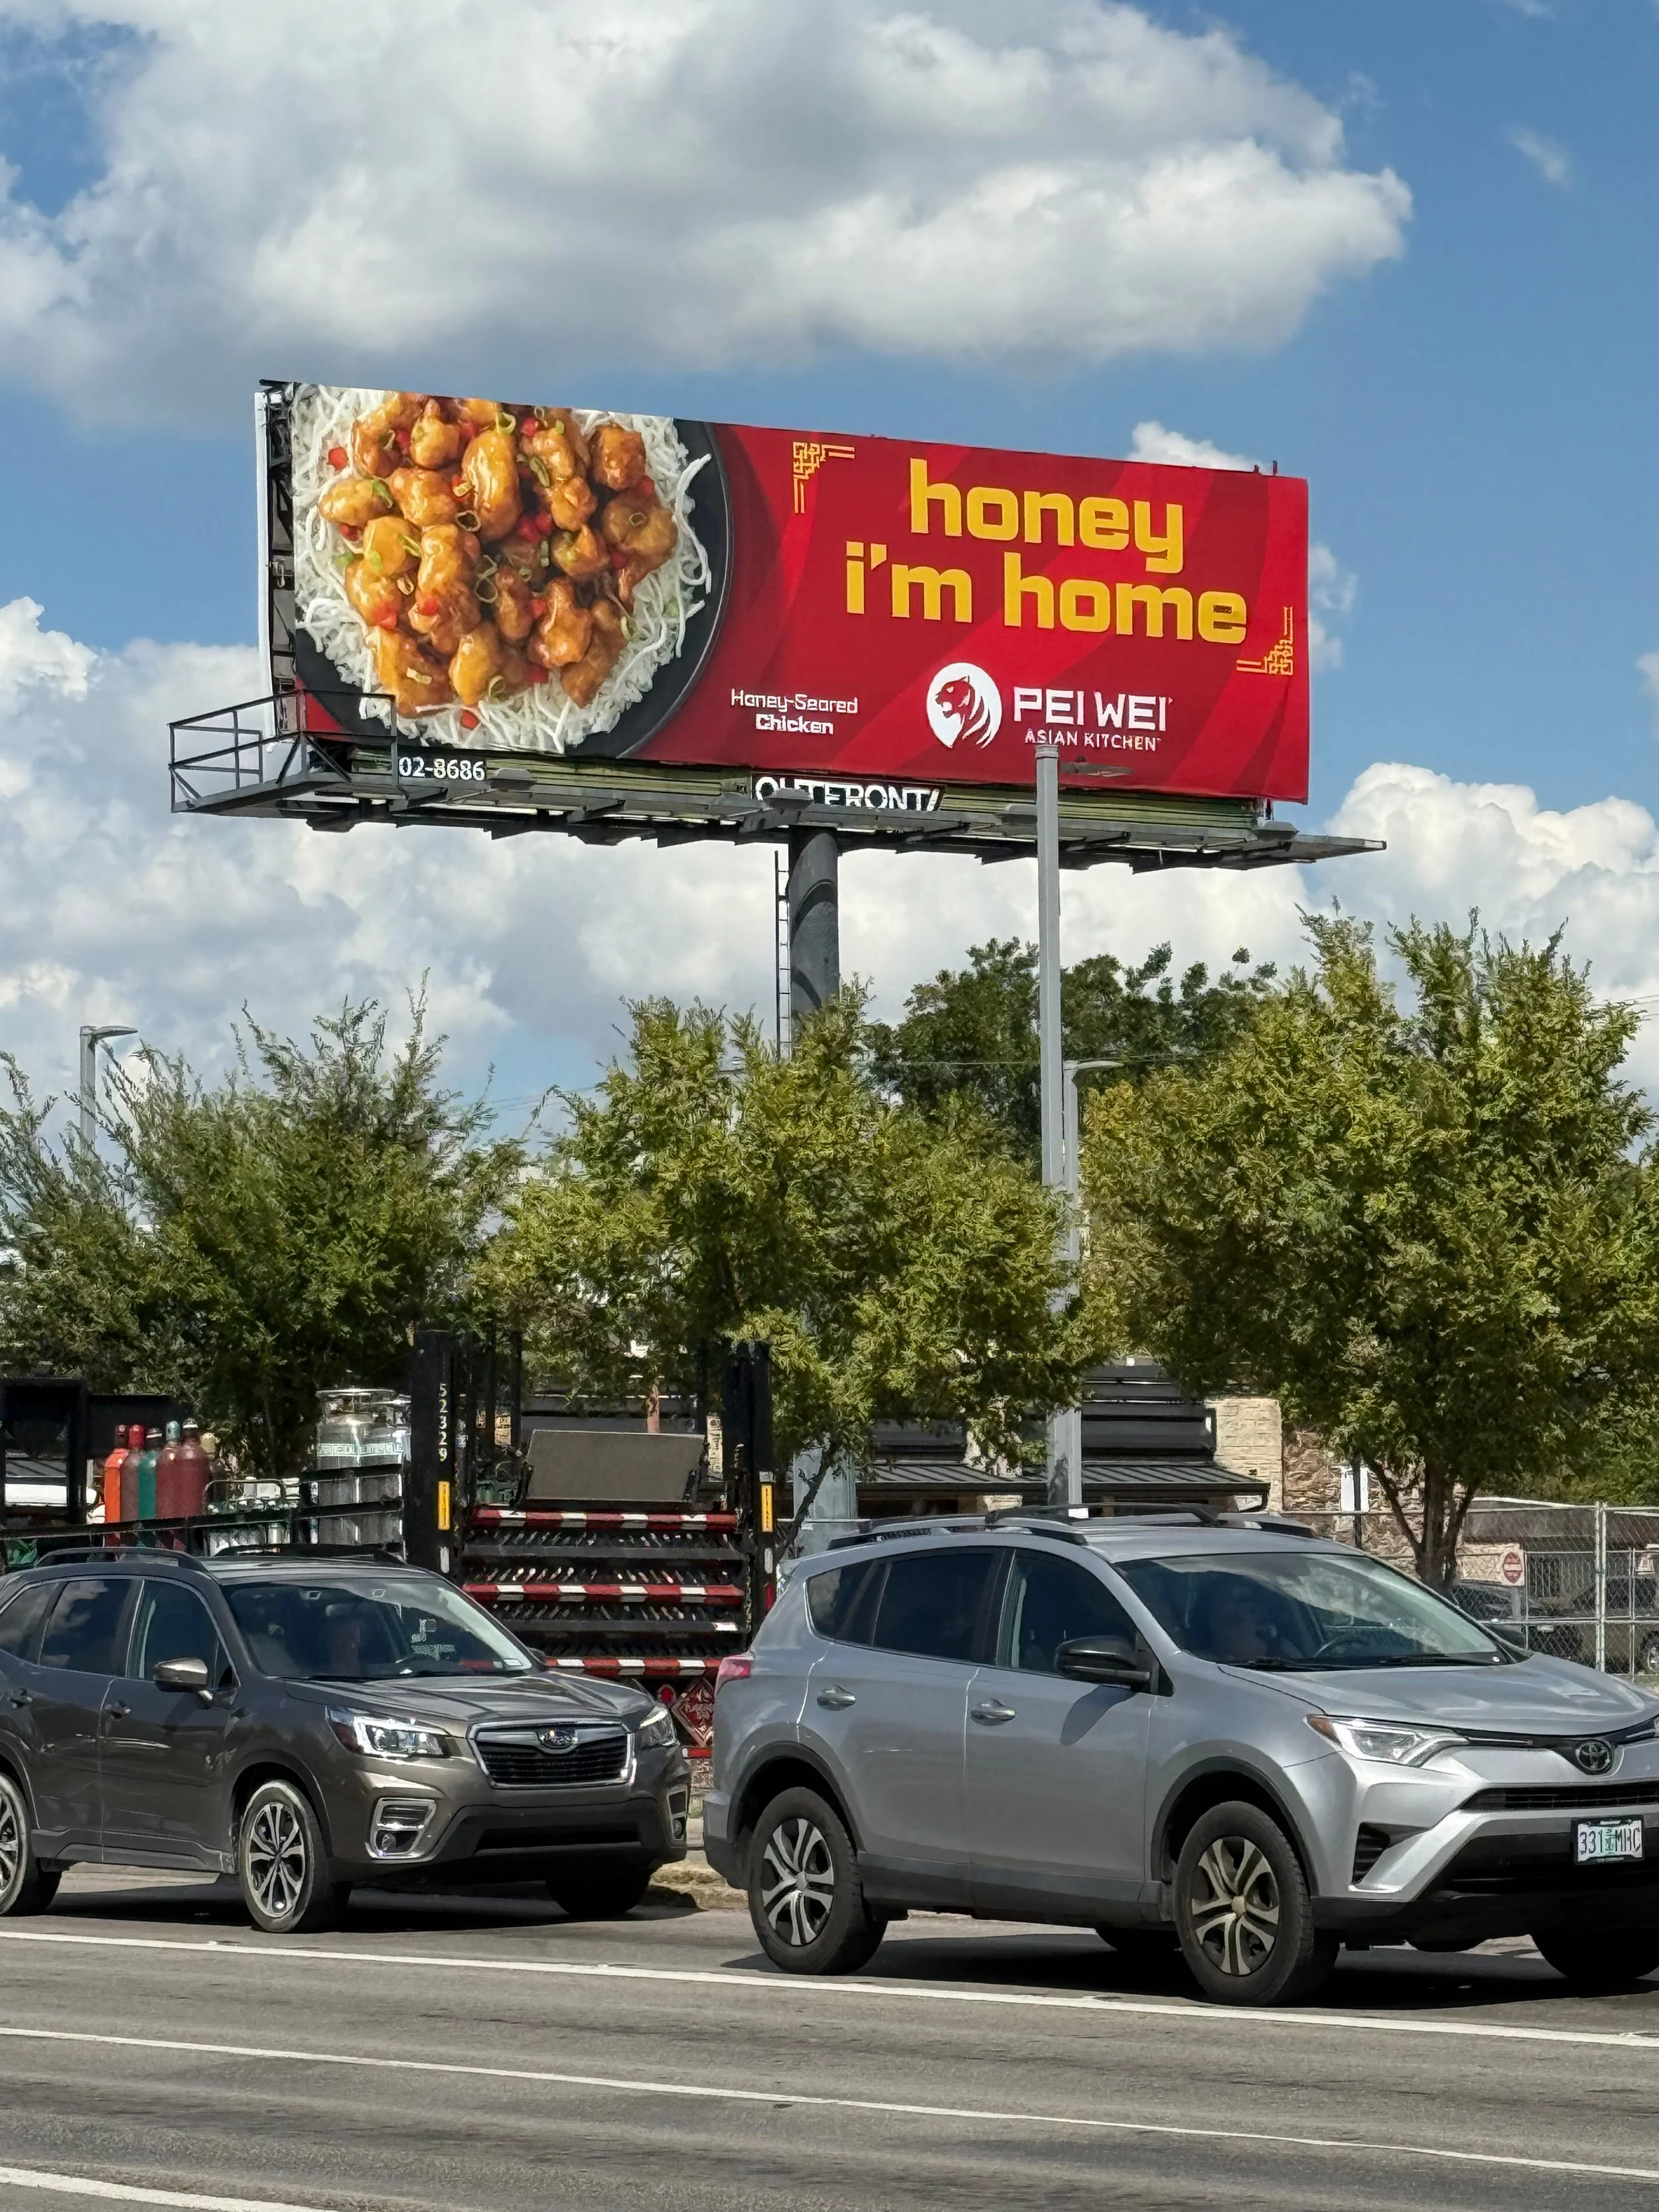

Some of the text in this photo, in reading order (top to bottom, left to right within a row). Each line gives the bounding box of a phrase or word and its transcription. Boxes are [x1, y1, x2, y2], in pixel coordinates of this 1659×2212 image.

[910, 458, 1183, 574] honey
[846, 541, 1248, 644] i'm home
[731, 688, 858, 714] Honey-Seared
[1013, 686, 1167, 731] PEI WEI
[755, 713, 834, 735] Chicken
[1025, 728, 1157, 752] ASIAN KITCHEN
[398, 756, 485, 781] 02-8686
[1579, 1829, 1603, 1856] 331
